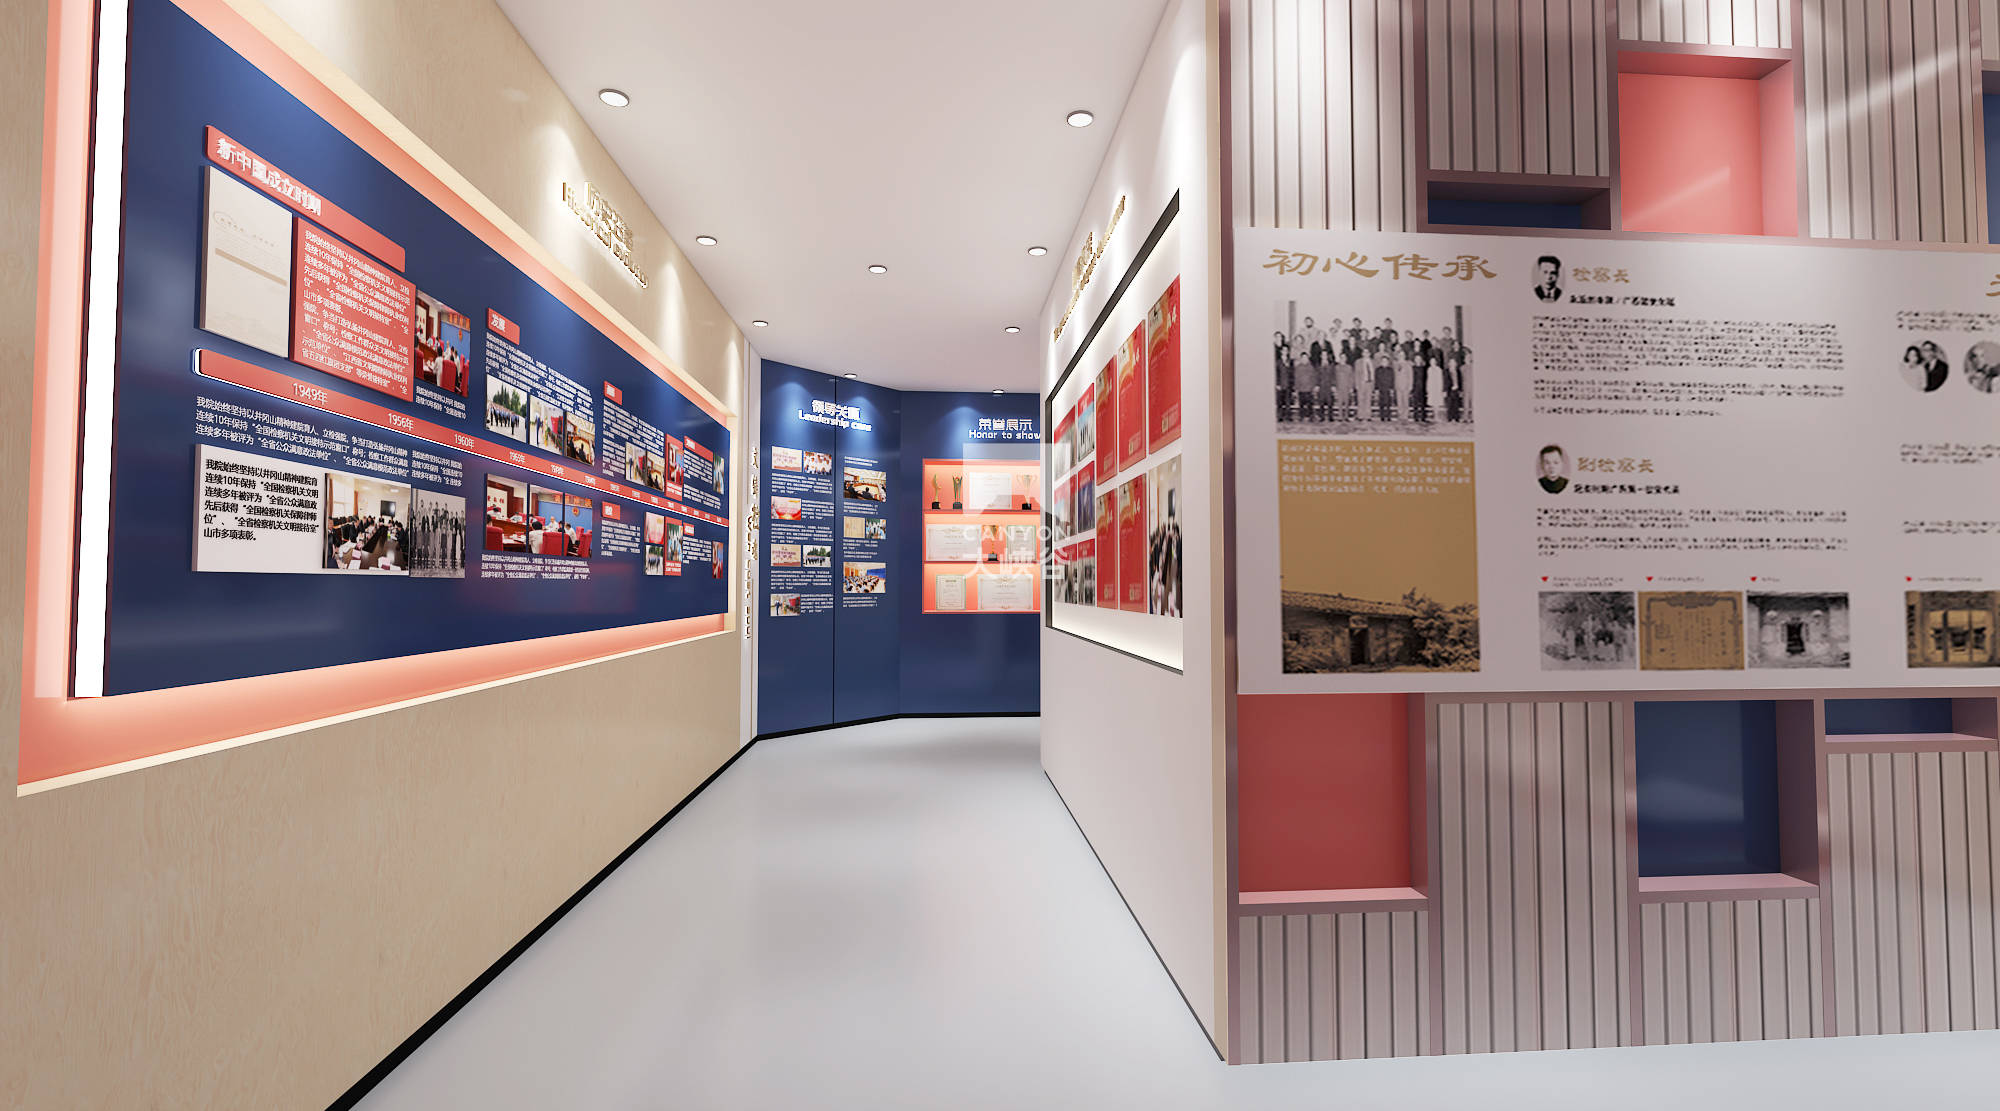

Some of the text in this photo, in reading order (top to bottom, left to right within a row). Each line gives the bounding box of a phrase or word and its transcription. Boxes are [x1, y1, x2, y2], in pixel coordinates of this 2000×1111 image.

[1263, 249, 1498, 281] 初心传承
[292, 382, 328, 405] 1949年
[388, 412, 415, 431] 1956年
[978, 418, 1033, 431] 荣誉展示
[454, 433, 475, 449] 1960年
[968, 429, 998, 439] Honor
[1002, 431, 1013, 439] to
